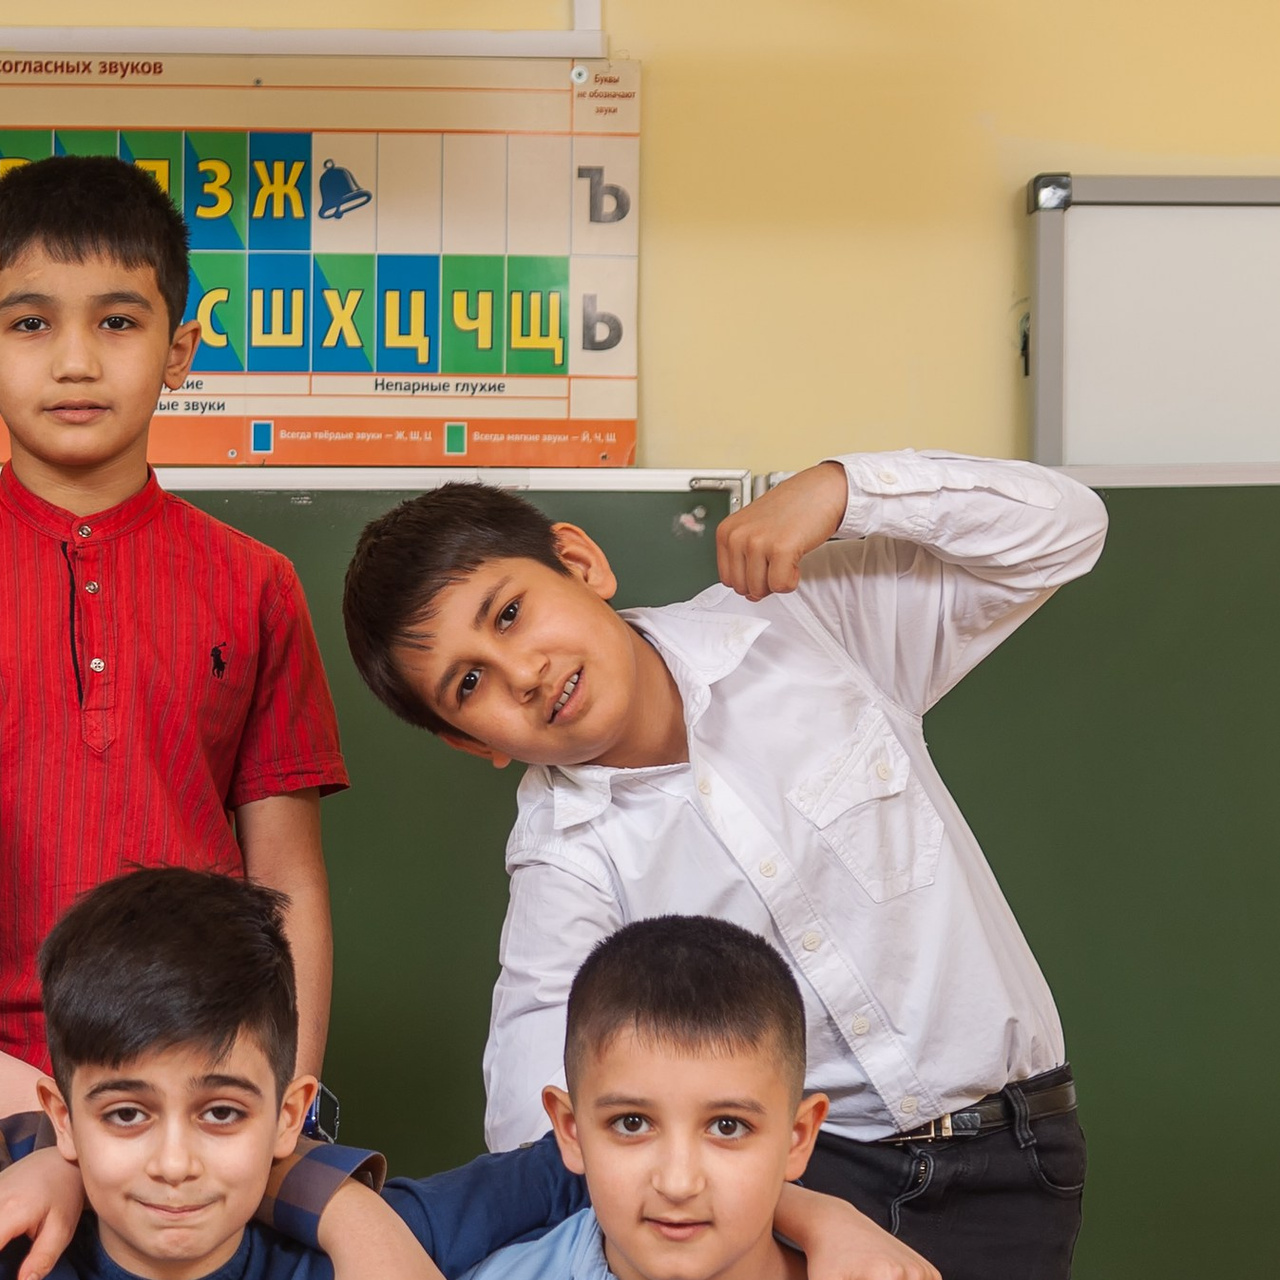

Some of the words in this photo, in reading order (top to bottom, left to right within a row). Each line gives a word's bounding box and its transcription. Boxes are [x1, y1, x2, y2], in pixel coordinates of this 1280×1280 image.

[99, 60, 164, 79] звуков
[594, 73, 620, 85] Буквы
[588, 89, 636, 99] обозначают
[595, 106, 618, 115] звуки
[374, 378, 450, 395] Непарные
[455, 381, 506, 396] глухие
[183, 401, 226, 415] звуки
[280, 429, 312, 441] Всегда
[313, 430, 354, 441] твёрдые
[356, 431, 382, 441] звуки
[473, 431, 505, 442] Всегда
[542, 433, 568, 443] звуки
